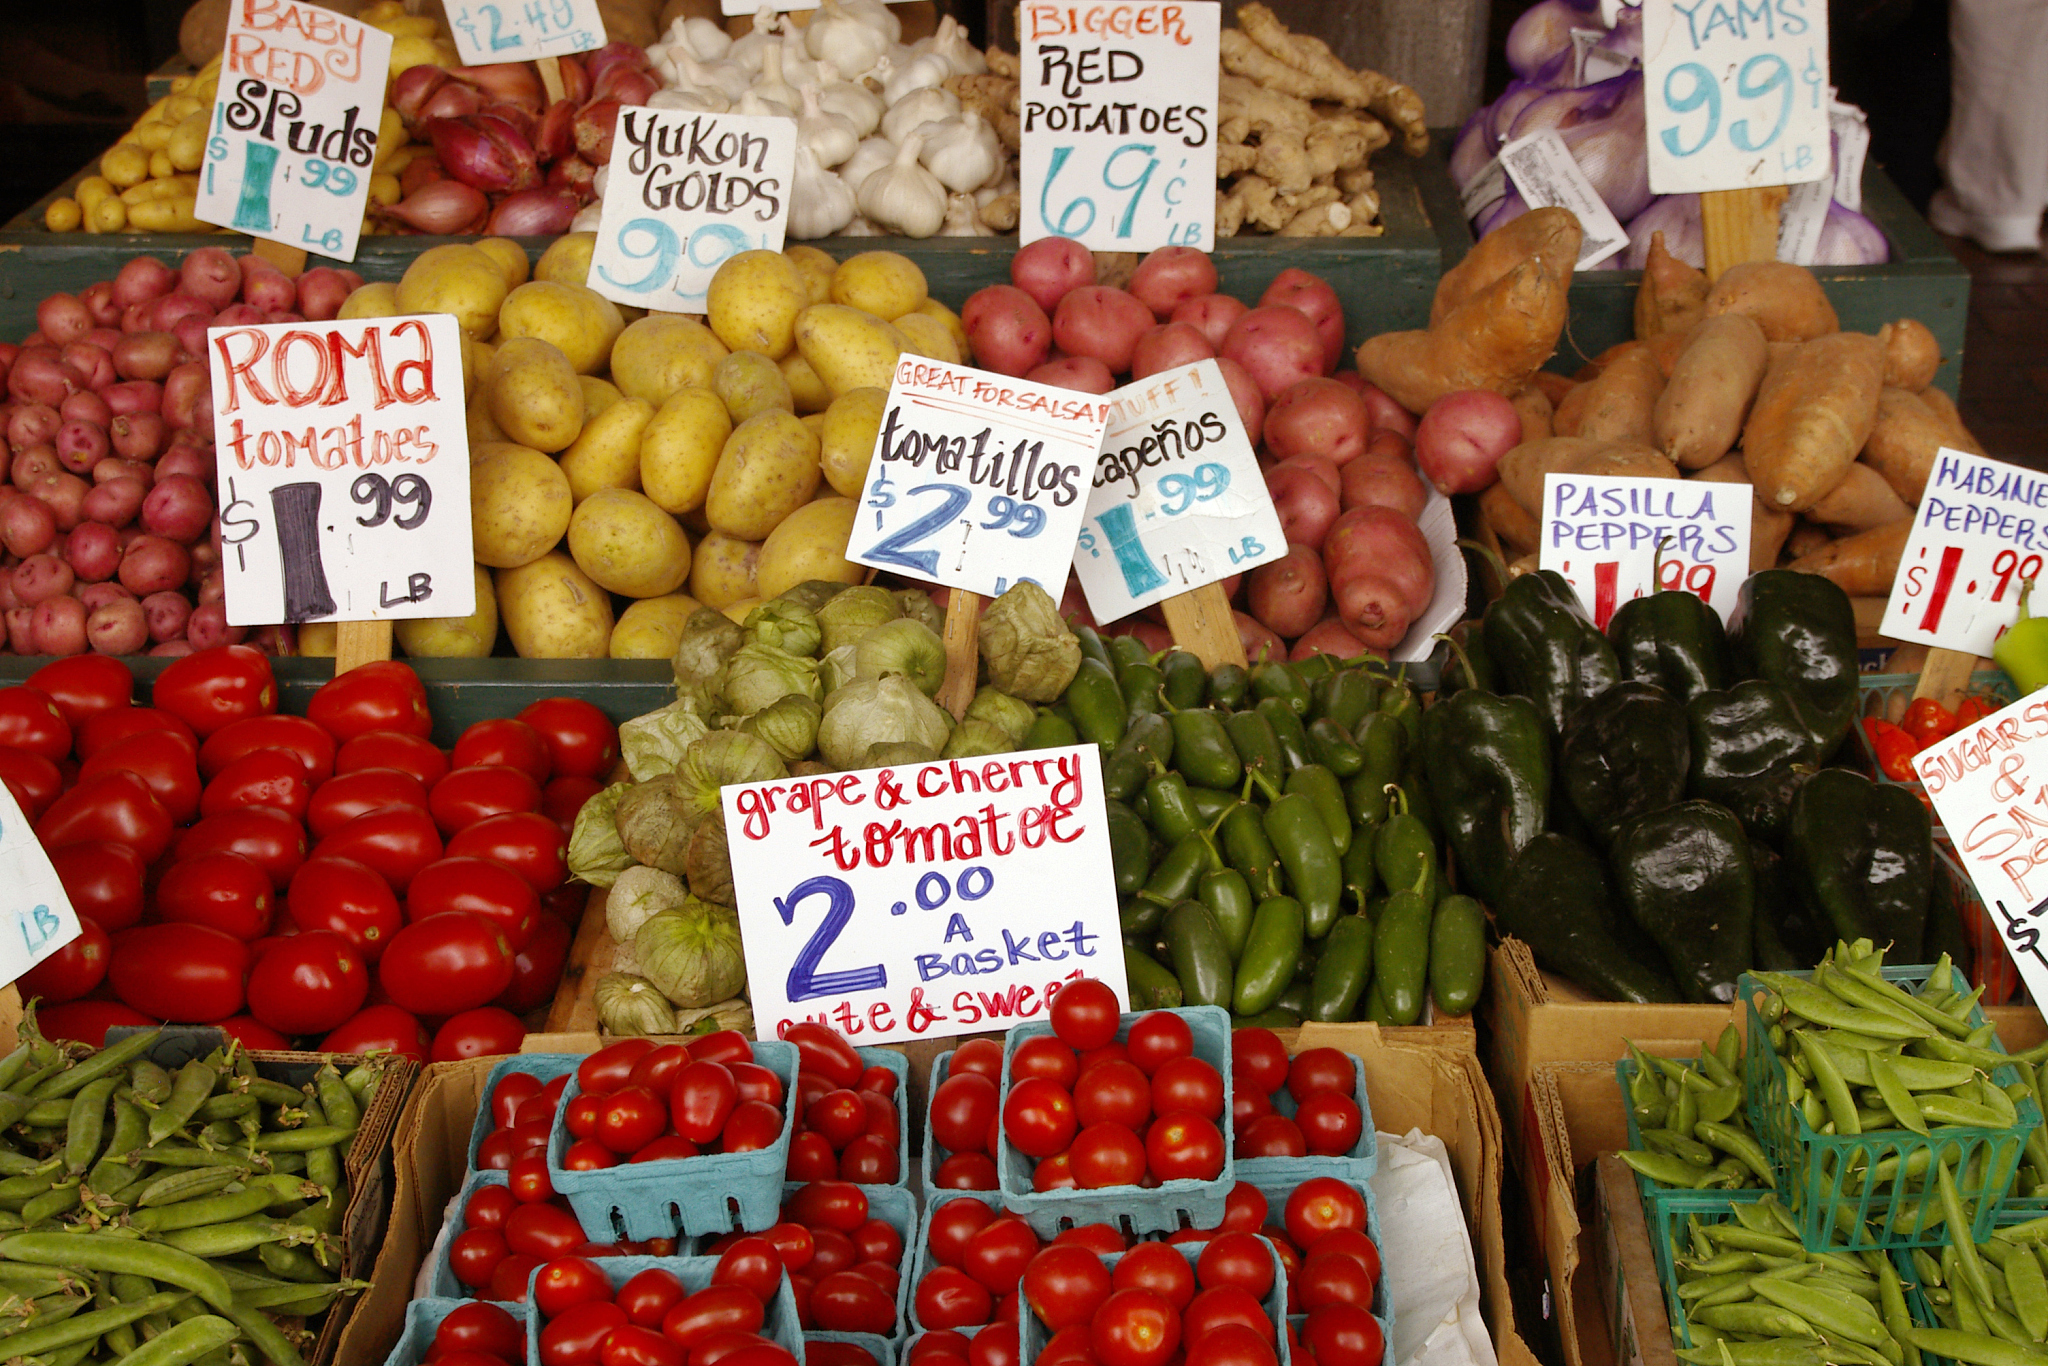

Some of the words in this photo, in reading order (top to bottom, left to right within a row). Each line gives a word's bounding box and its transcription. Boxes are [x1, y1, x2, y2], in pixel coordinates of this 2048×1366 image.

[241, 0, 365, 83] BABY
[571, 31, 596, 50] LB
[1027, 5, 1193, 46] BIGGER
[1673, 0, 1809, 50] YAMS
[229, 33, 326, 97] RED
[1038, 44, 1144, 99] RED
[1024, 102, 1208, 147] POTATOES
[1780, 144, 1813, 173] LB
[642, 163, 780, 222] GOLDS
[301, 223, 343, 252] LB
[1167, 222, 1202, 246] LB
[597, 218, 768, 301] 99
[896, 361, 973, 395] GREAT
[972, 381, 1013, 407] FOR
[226, 413, 440, 471] tomatoes
[880, 406, 1081, 507] tomatillos
[1555, 483, 1716, 521] PASILLA
[1228, 535, 1266, 565] LB
[1550, 520, 1738, 563] PEPPERS
[379, 572, 433, 609] LB
[1991, 752, 2030, 803] &
[736, 774, 867, 840] grape
[873, 768, 912, 813] &
[20, 904, 60, 957] LB
[773, 866, 995, 1003] 2.00
[944, 912, 975, 944] A
[776, 1001, 897, 1041] cte
[906, 986, 947, 1034] &
